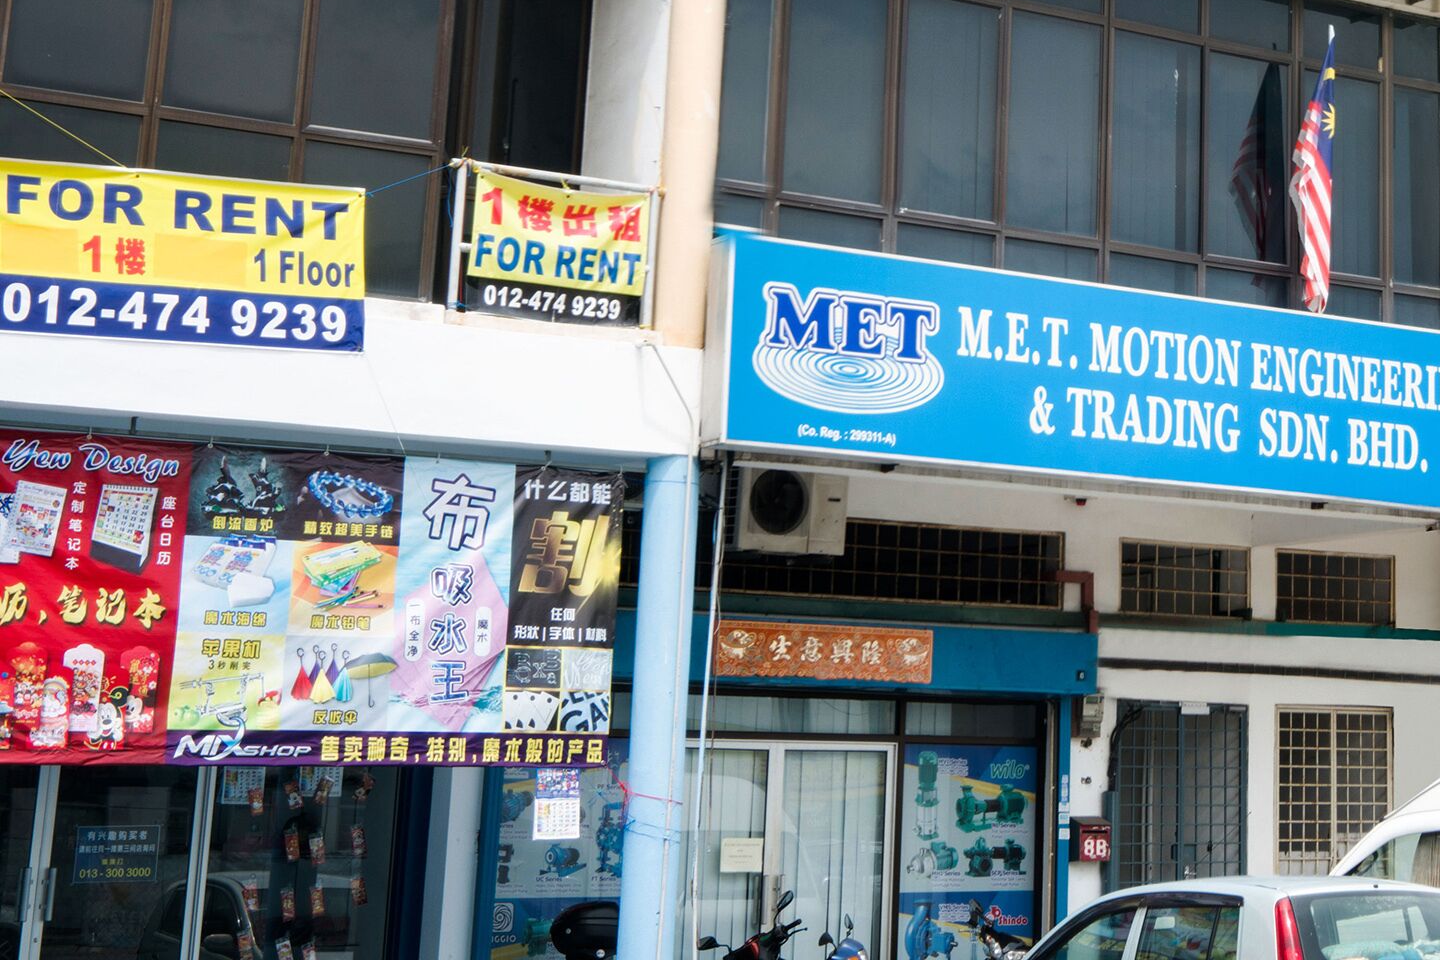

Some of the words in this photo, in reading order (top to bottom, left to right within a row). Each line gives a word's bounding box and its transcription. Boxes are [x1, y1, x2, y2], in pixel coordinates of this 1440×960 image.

[6, 174, 146, 227] FOR
[174, 189, 350, 240] RENT
[82, 235, 146, 276] 1楼
[254, 248, 267, 282] 1
[279, 250, 355, 288] Floor
[474, 233, 545, 275] FOR
[554, 245, 642, 286] RENT
[2, 282, 210, 334] 012-474
[231, 299, 347, 342] 9239
[484, 285, 566, 314] 012-474
[571, 296, 621, 320] 9239
[763, 281, 940, 365] MET
[956, 305, 1078, 370] M.E.T.
[1088, 323, 1242, 387] MOTION
[1029, 385, 1055, 435] &
[1066, 387, 1240, 452] TRADING
[1259, 407, 1339, 463] SDN.
[1347, 418, 1428, 473] BHD.
[2, 439, 72, 472] Yew
[78, 443, 180, 484] Design
[524, 479, 612, 505] 什么都能
[65, 481, 87, 570] 定制笔记本
[156, 496, 177, 566] 座台日历
[213, 515, 274, 532] 倒流香炉
[303, 520, 394, 539] 精致超美手链
[518, 511, 610, 597] 割
[423, 473, 497, 704] 布吸水王
[203, 610, 267, 627] 魔术海绵
[310, 614, 371, 630] 魔术铅笔
[551, 607, 576, 622] 任何
[202, 639, 261, 659] 苹果机
[313, 710, 358, 725] 反收伞
[990, 759, 1027, 779] wilo
